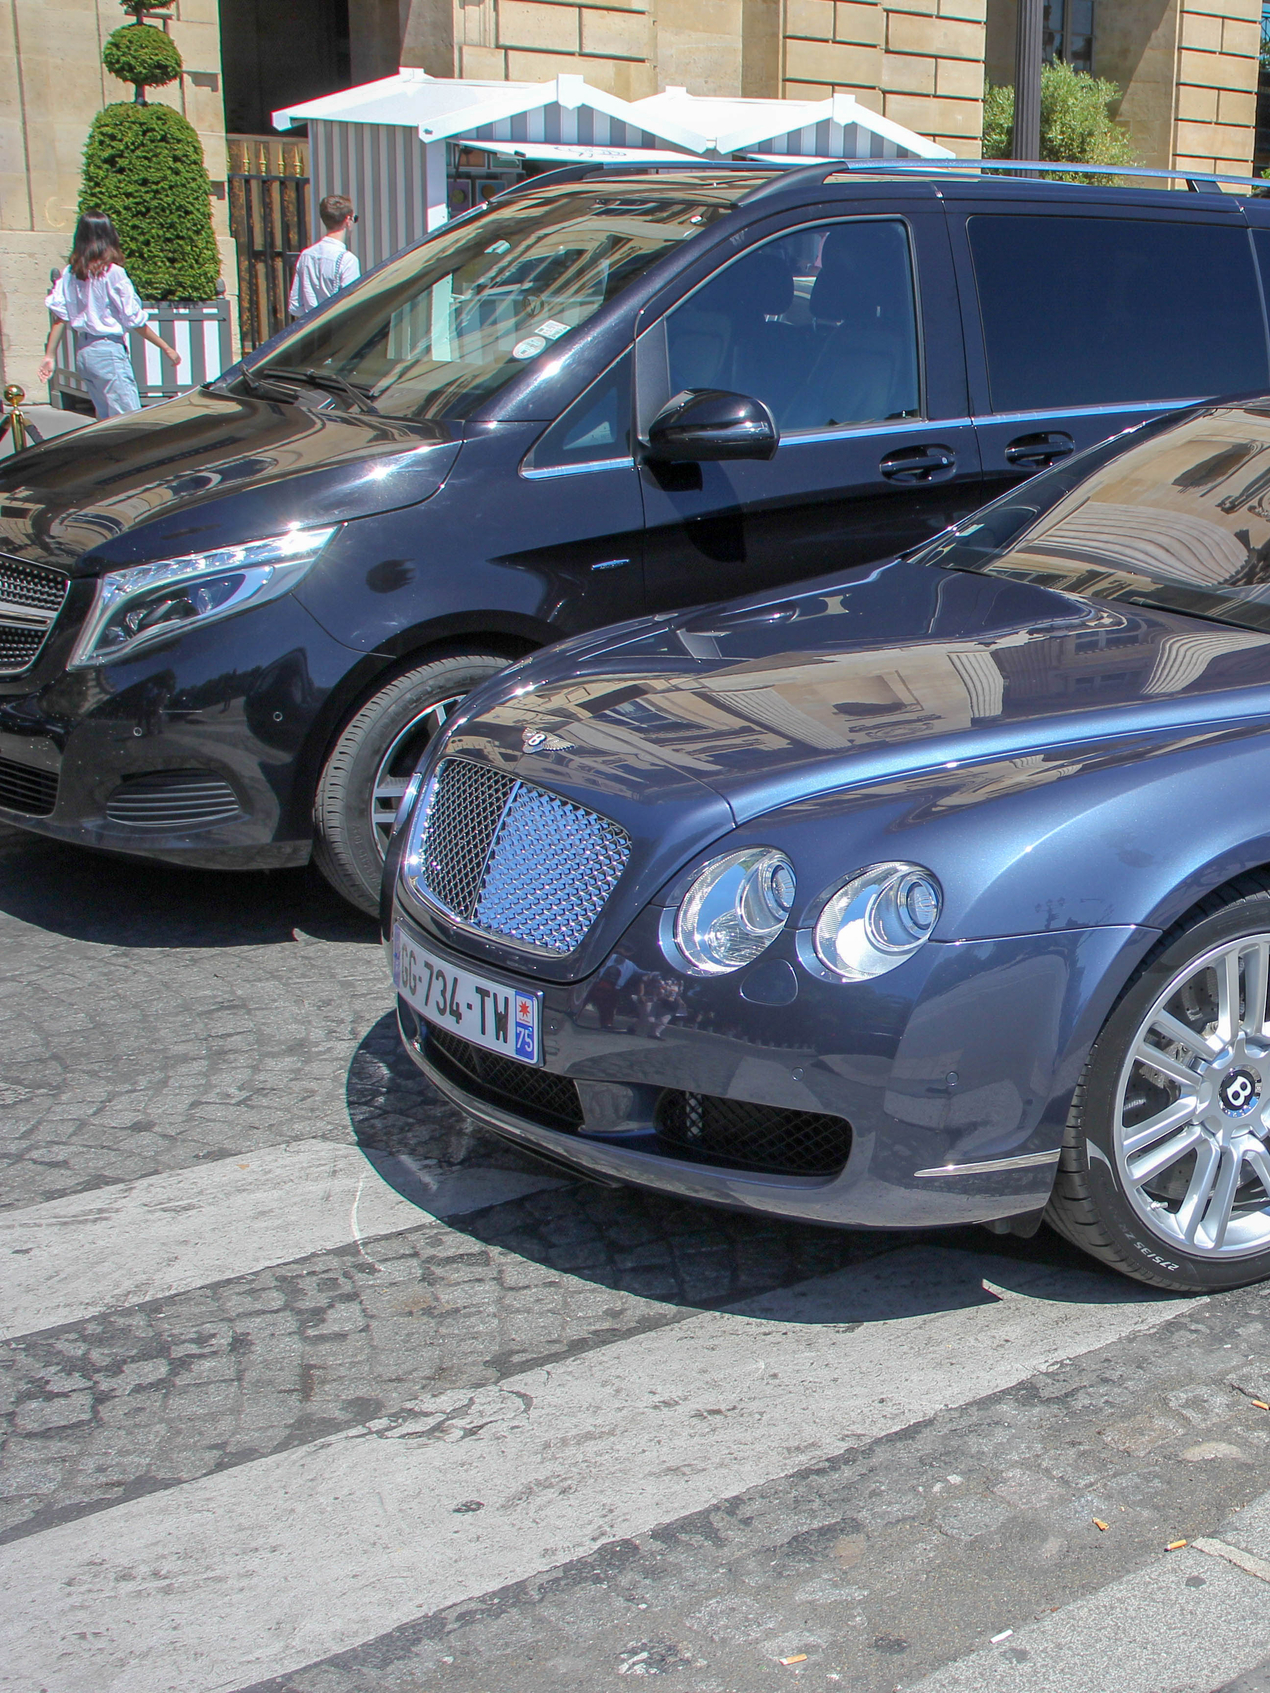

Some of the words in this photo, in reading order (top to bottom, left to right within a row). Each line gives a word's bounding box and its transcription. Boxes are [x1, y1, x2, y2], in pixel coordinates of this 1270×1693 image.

[401, 943, 509, 1044] GG-734-TW
[516, 1027, 533, 1052] 75
[1227, 1076, 1252, 1107] B
[1133, 1241, 1180, 1272] 275/35
